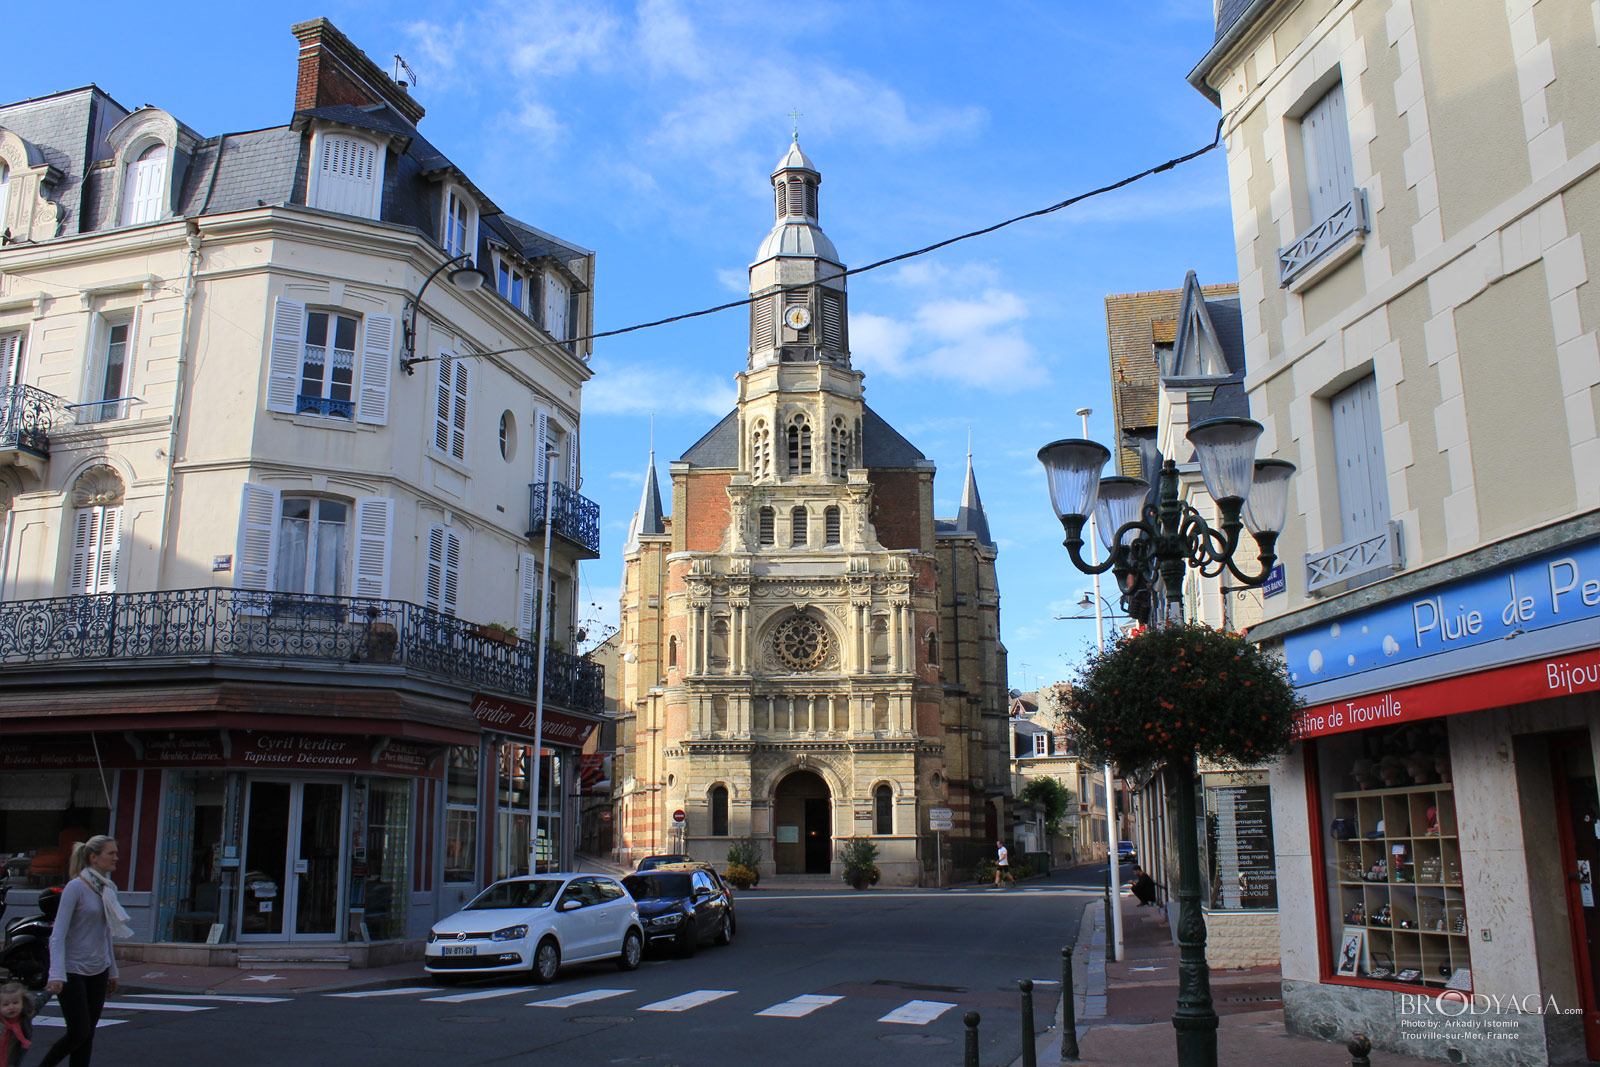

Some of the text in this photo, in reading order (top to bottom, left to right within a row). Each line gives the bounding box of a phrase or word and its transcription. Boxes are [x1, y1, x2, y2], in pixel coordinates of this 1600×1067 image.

[1271, 580, 1283, 591] BAINS
[1412, 595, 1484, 648] Pluie
[1501, 572, 1537, 626] de
[1546, 663, 1600, 694] Bijou
[473, 700, 515, 724] Verdier
[1328, 705, 1344, 728] de
[1346, 693, 1403, 724] Trouville
[257, 735, 347, 752] Cyril Verdier
[244, 750, 359, 765] Tapissier Décorateur
